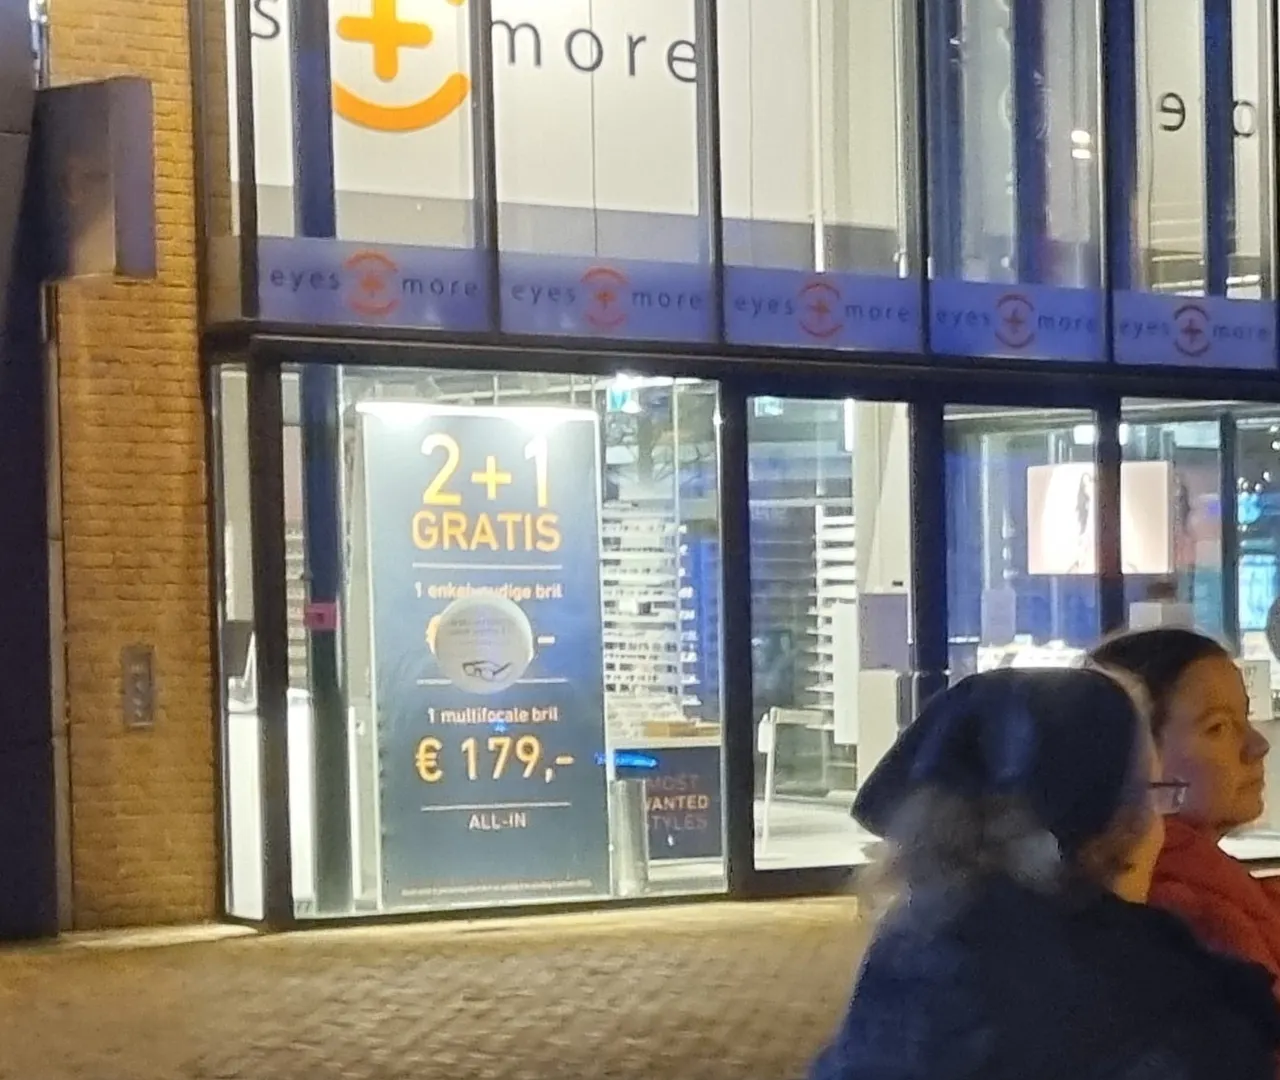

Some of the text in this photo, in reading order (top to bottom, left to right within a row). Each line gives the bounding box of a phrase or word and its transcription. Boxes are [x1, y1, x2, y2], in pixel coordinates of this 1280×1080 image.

[491, 19, 697, 82] more
[270, 269, 478, 297] eyes more
[511, 284, 703, 311] eyes more
[735, 296, 911, 322] eyes more
[412, 510, 561, 552] GRATIS
[414, 580, 423, 598] 1
[535, 582, 564, 600] bril
[428, 706, 559, 724] 1 multifocale bril
[415, 735, 575, 783] € 179,-
[468, 811, 527, 830] ALL-IN
[651, 813, 708, 831] TYLES
